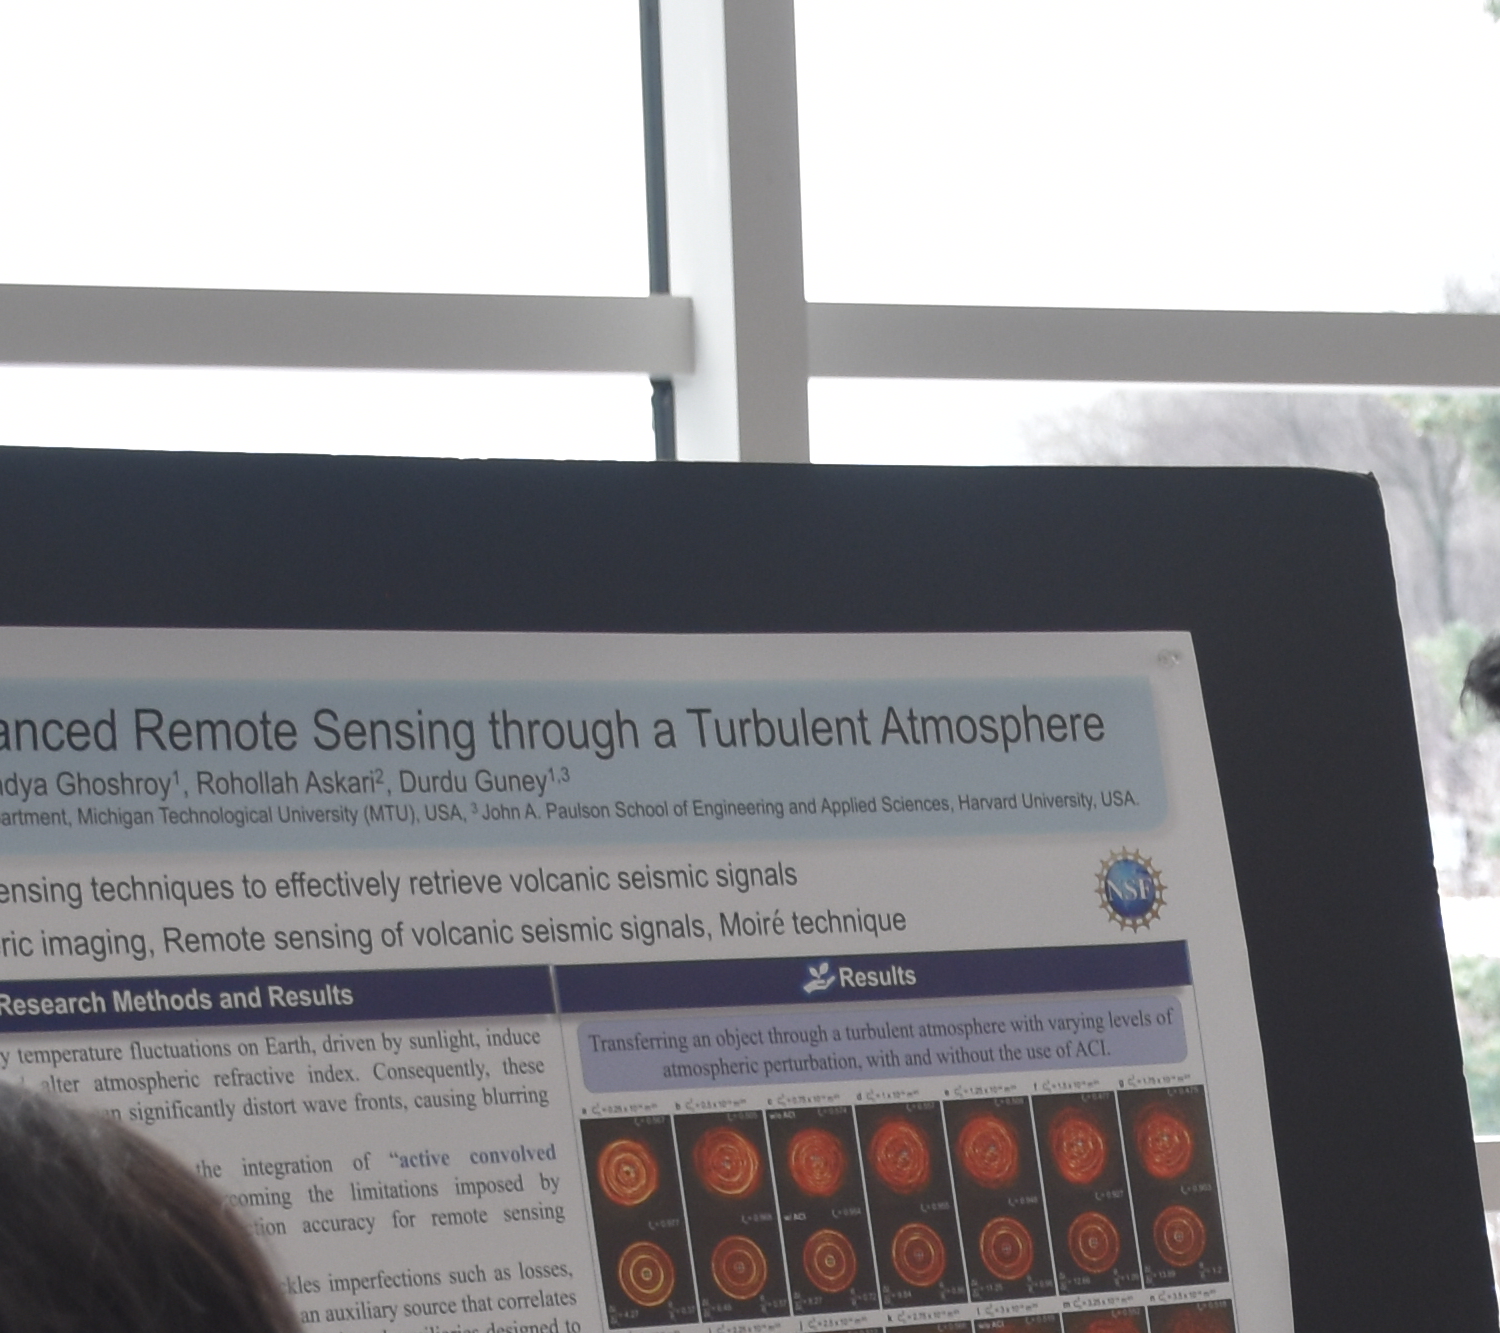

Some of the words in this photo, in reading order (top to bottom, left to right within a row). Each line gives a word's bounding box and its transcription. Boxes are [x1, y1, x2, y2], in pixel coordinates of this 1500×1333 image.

[134, 708, 297, 752] Remote
[314, 708, 475, 761] Sensing
[488, 708, 639, 760] through
[653, 718, 676, 749] a
[686, 707, 871, 748] Turbulent
[881, 704, 1105, 753] Atmosphere
[197, 770, 298, 795] Rohollah
[399, 769, 467, 793] Durdu
[90, 874, 234, 907] techniques
[242, 874, 267, 899] to
[275, 870, 400, 903] effectively
[410, 869, 502, 895] retrieve
[509, 866, 610, 893] volcanic
[618, 863, 709, 890] seismic
[716, 861, 797, 893] signals
[1106, 877, 1153, 902] NSF
[41, 929, 154, 962] imaging,
[163, 926, 265, 953] Remote
[274, 923, 373, 955] sensing
[381, 921, 403, 947] of
[411, 919, 514, 946] volcanic
[521, 916, 613, 943] seismic
[620, 913, 712, 946] signals,
[719, 909, 785, 937] Moiré
[792, 908, 906, 938] technique
[839, 965, 916, 987] Results
[112, 988, 212, 1012] Methods
[220, 986, 262, 1009] and
[268, 984, 353, 1007] Results
